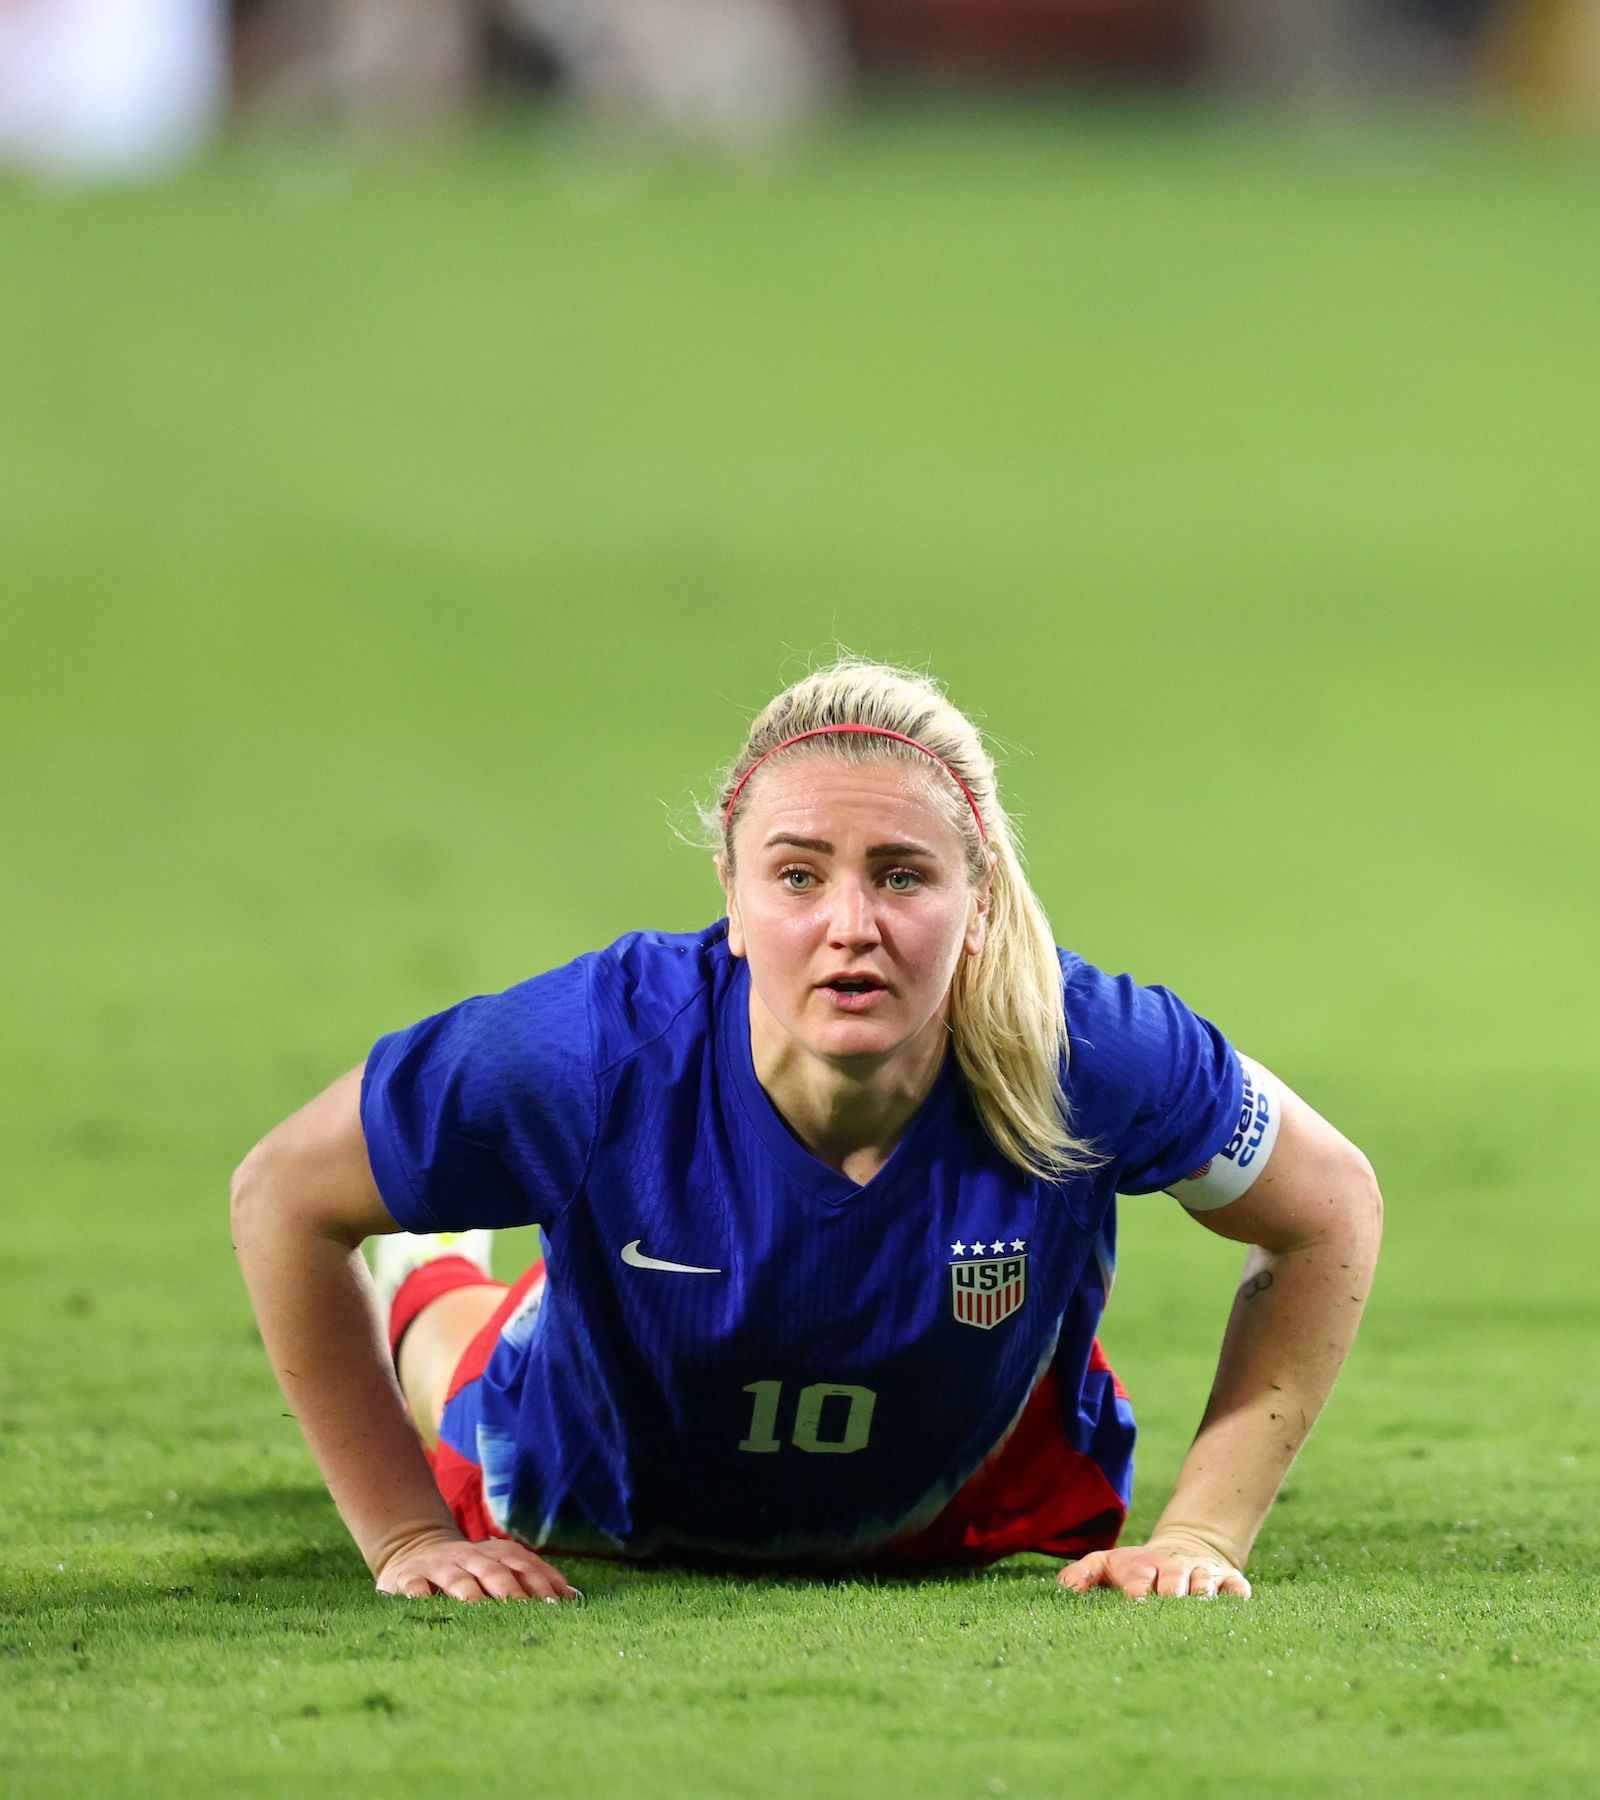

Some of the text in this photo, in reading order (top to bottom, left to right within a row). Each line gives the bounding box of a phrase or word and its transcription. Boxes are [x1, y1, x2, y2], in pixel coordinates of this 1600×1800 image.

[1238, 1093, 1269, 1167] cup
[956, 1261, 1021, 1290] USA
[738, 1380, 877, 1453] 10
